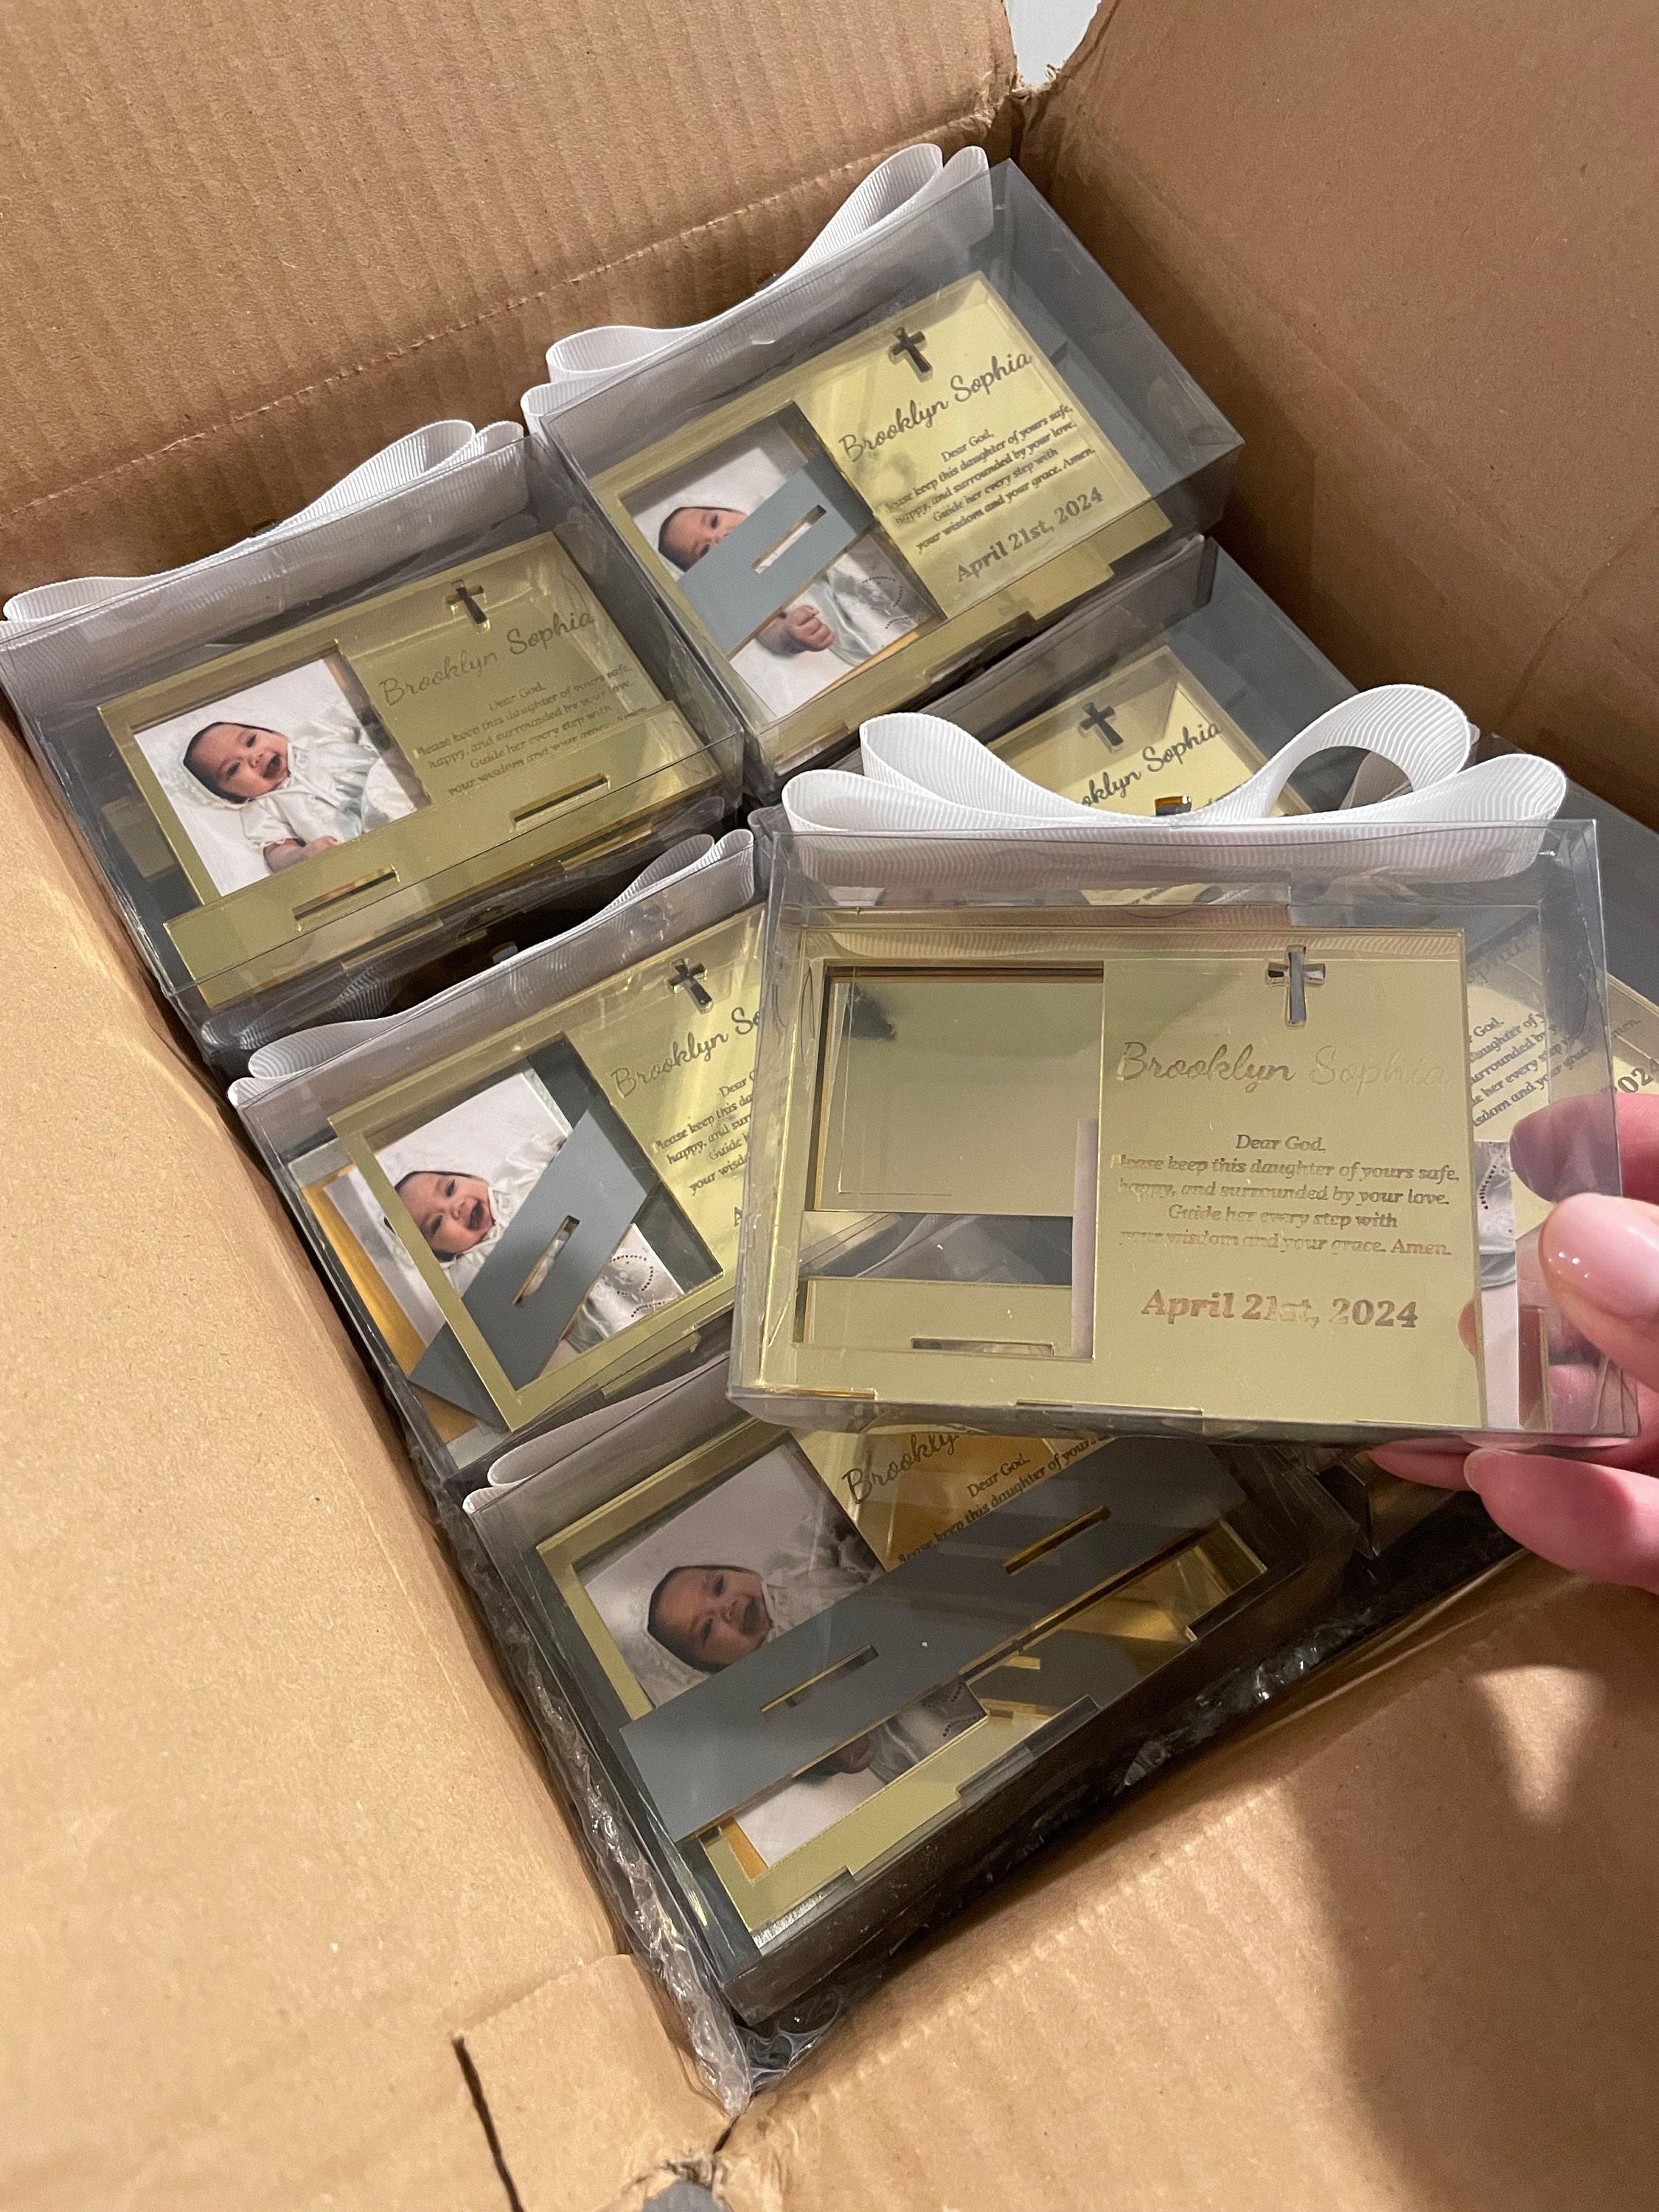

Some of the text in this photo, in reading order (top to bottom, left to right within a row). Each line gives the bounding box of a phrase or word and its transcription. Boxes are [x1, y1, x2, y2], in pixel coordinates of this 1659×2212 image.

[838, 353, 1032, 462] Brooklyn Sophia
[913, 479, 939, 495] keep
[939, 467, 959, 482] this
[960, 440, 1006, 471] daughter
[1007, 430, 1019, 445] of
[1018, 417, 1049, 442] yours
[932, 487, 953, 505] and
[953, 453, 1013, 493] surrounded
[1012, 448, 1026, 460] by
[1026, 434, 1051, 456] your
[940, 443, 967, 462] Dear
[933, 448, 1060, 522] Guide her every step with
[916, 532, 942, 554] your
[942, 508, 984, 535] wisdom
[984, 494, 1006, 513] and
[1005, 482, 1030, 504] your
[957, 486, 1104, 583] April 21st, 2024
[378, 611, 596, 707] Brooklyn Sophia
[505, 692, 557, 720] daughter
[470, 736, 495, 752] and
[495, 706, 563, 741] surrounded
[1142, 723, 1222, 773] Sophia
[470, 750, 505, 769] Guide
[505, 740, 526, 754] her
[1523, 1013, 1538, 1029] of
[610, 1031, 729, 1099] Brooklyn
[1116, 1040, 1450, 1096] Brooklyn Sophia
[1470, 1038, 1537, 1085] urrounded
[1480, 1080, 1504, 1098] her
[1505, 1060, 1539, 1084] every
[719, 1077, 747, 1098] Dear
[1474, 1099, 1512, 1127] sdom
[1511, 1081, 1537, 1103] and
[687, 1116, 715, 1134] keep
[715, 1102, 738, 1120] this
[708, 1124, 730, 1143] and
[709, 1136, 743, 1161] Guide
[1235, 1133, 1282, 1150] Dear
[688, 1172, 716, 1196] your
[1167, 1155, 1209, 1176] keep
[1211, 1157, 1247, 1174] this
[1250, 1158, 1335, 1180] daughter
[1338, 1161, 1361, 1181] of
[1360, 1166, 1415, 1182] yours
[1180, 1180, 1217, 1197] and
[1220, 1183, 1329, 1201] surrounded
[1332, 1186, 1354, 1206] by
[1355, 1190, 1404, 1207] your
[1168, 1203, 1399, 1231] Guide her every step with
[1166, 1228, 1239, 1246] wisdom
[1242, 1233, 1279, 1248] and
[1279, 1237, 1328, 1253] your
[1390, 1238, 1453, 1256] Amen.
[1141, 1288, 1419, 1329] April 21st, 2024
[841, 1433, 959, 1505] Brookly
[964, 1502, 990, 1524] this
[991, 1467, 1046, 1509] daughter
[1047, 1453, 1062, 1471] of
[966, 1472, 999, 1498] Dear
